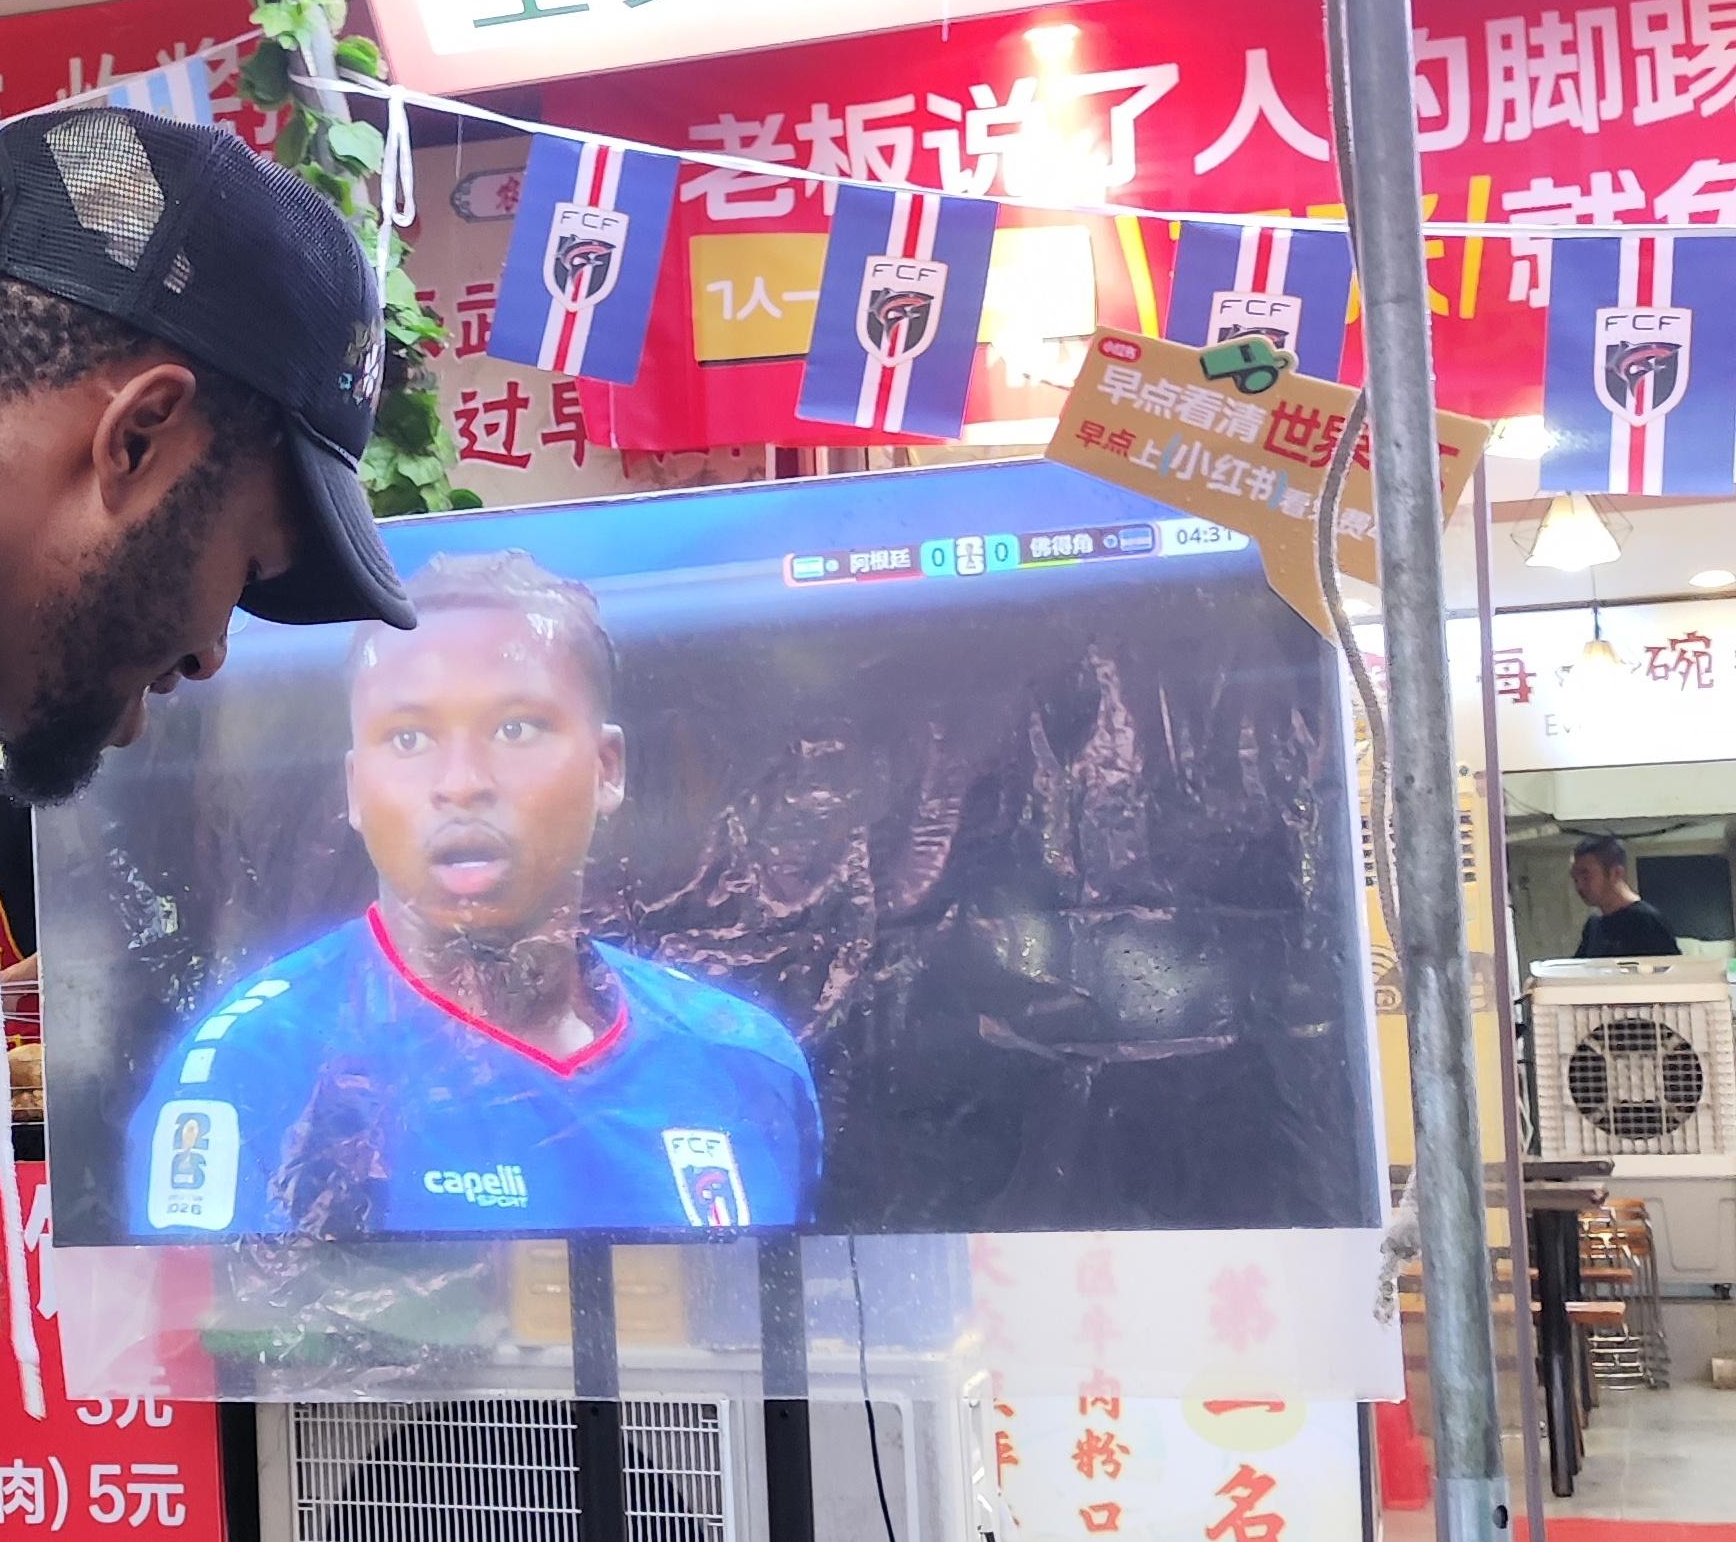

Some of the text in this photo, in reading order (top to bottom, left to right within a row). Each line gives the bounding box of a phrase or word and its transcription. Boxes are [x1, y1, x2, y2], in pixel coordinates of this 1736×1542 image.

[560, 209, 620, 232] FCF
[871, 261, 939, 283] FCF
[1219, 298, 1293, 318] FCF
[1604, 314, 1681, 332] FCF
[1097, 364, 1461, 491] 早点看清世界
[931, 548, 946, 567] 0
[994, 542, 1009, 561] 0
[424, 1165, 527, 1204] capelli
[88, 1463, 187, 1528] 5元
